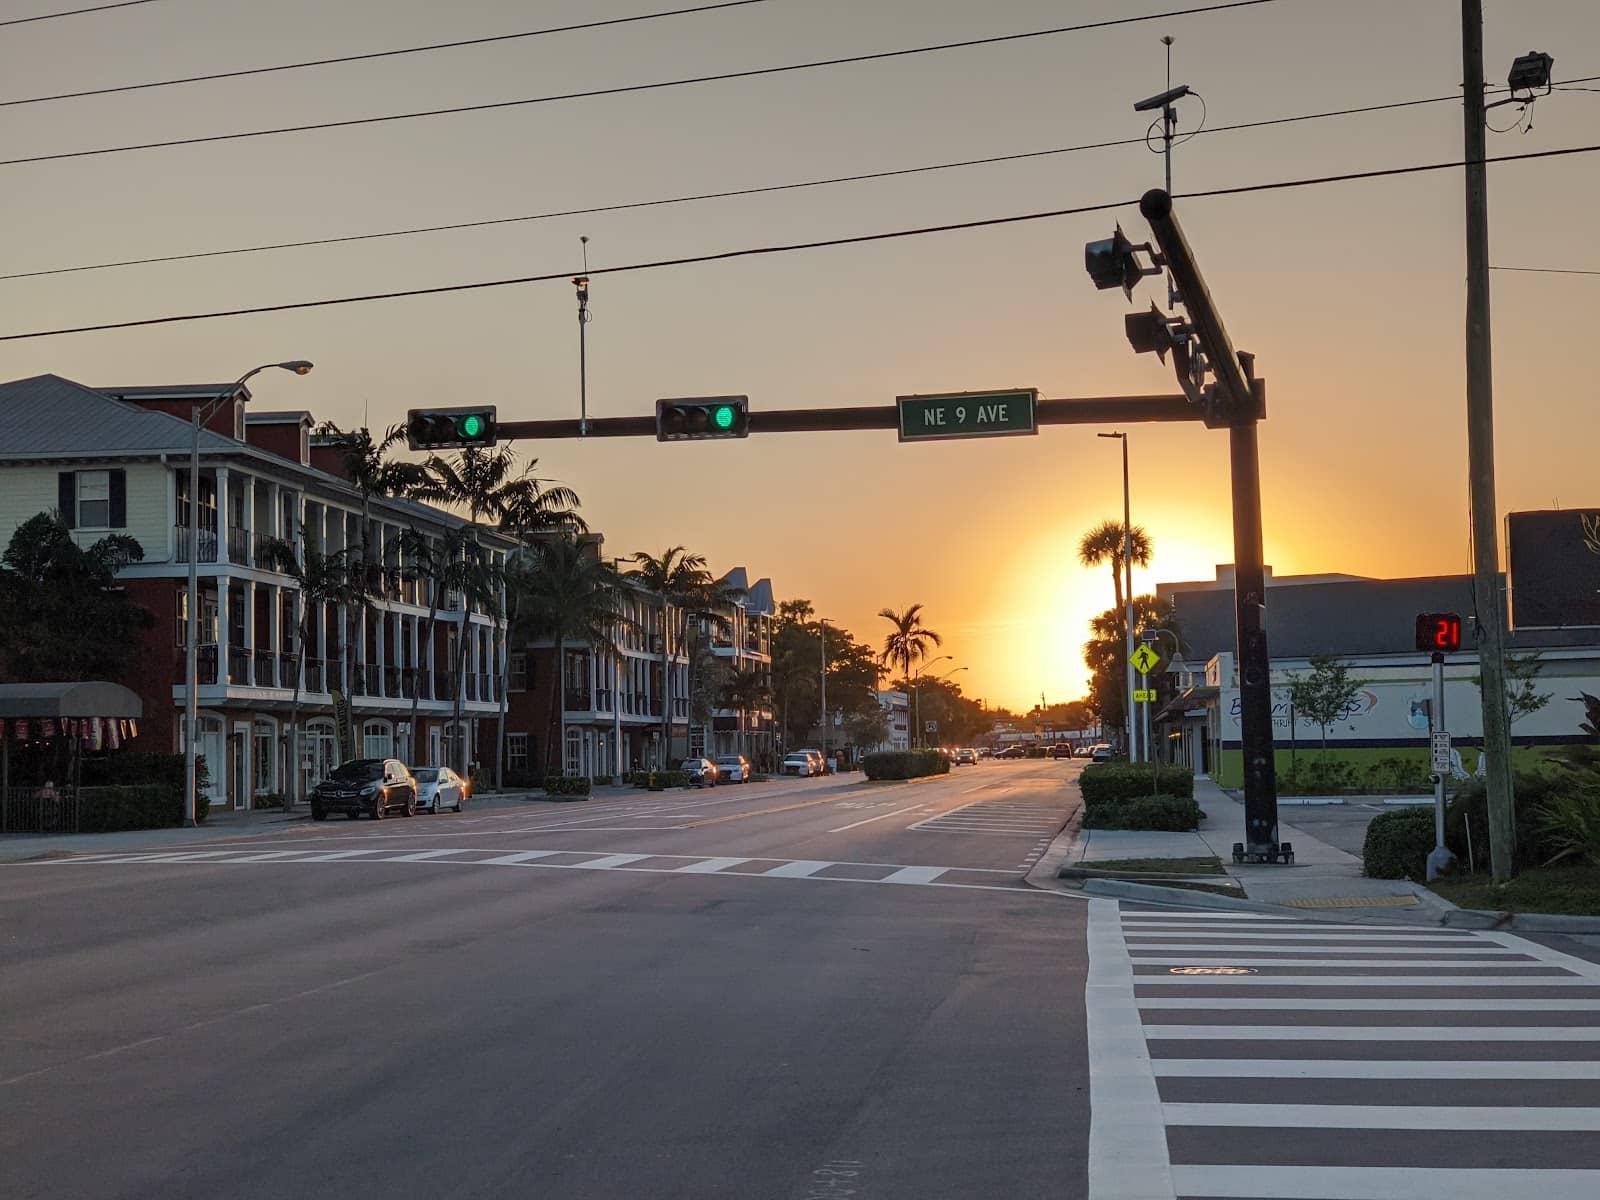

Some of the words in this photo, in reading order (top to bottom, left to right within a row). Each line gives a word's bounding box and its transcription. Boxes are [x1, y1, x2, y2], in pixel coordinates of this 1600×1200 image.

[924, 408, 946, 425] NE
[956, 406, 966, 424] 9
[977, 404, 1009, 424] AVE
[1436, 620, 1458, 646] 21
